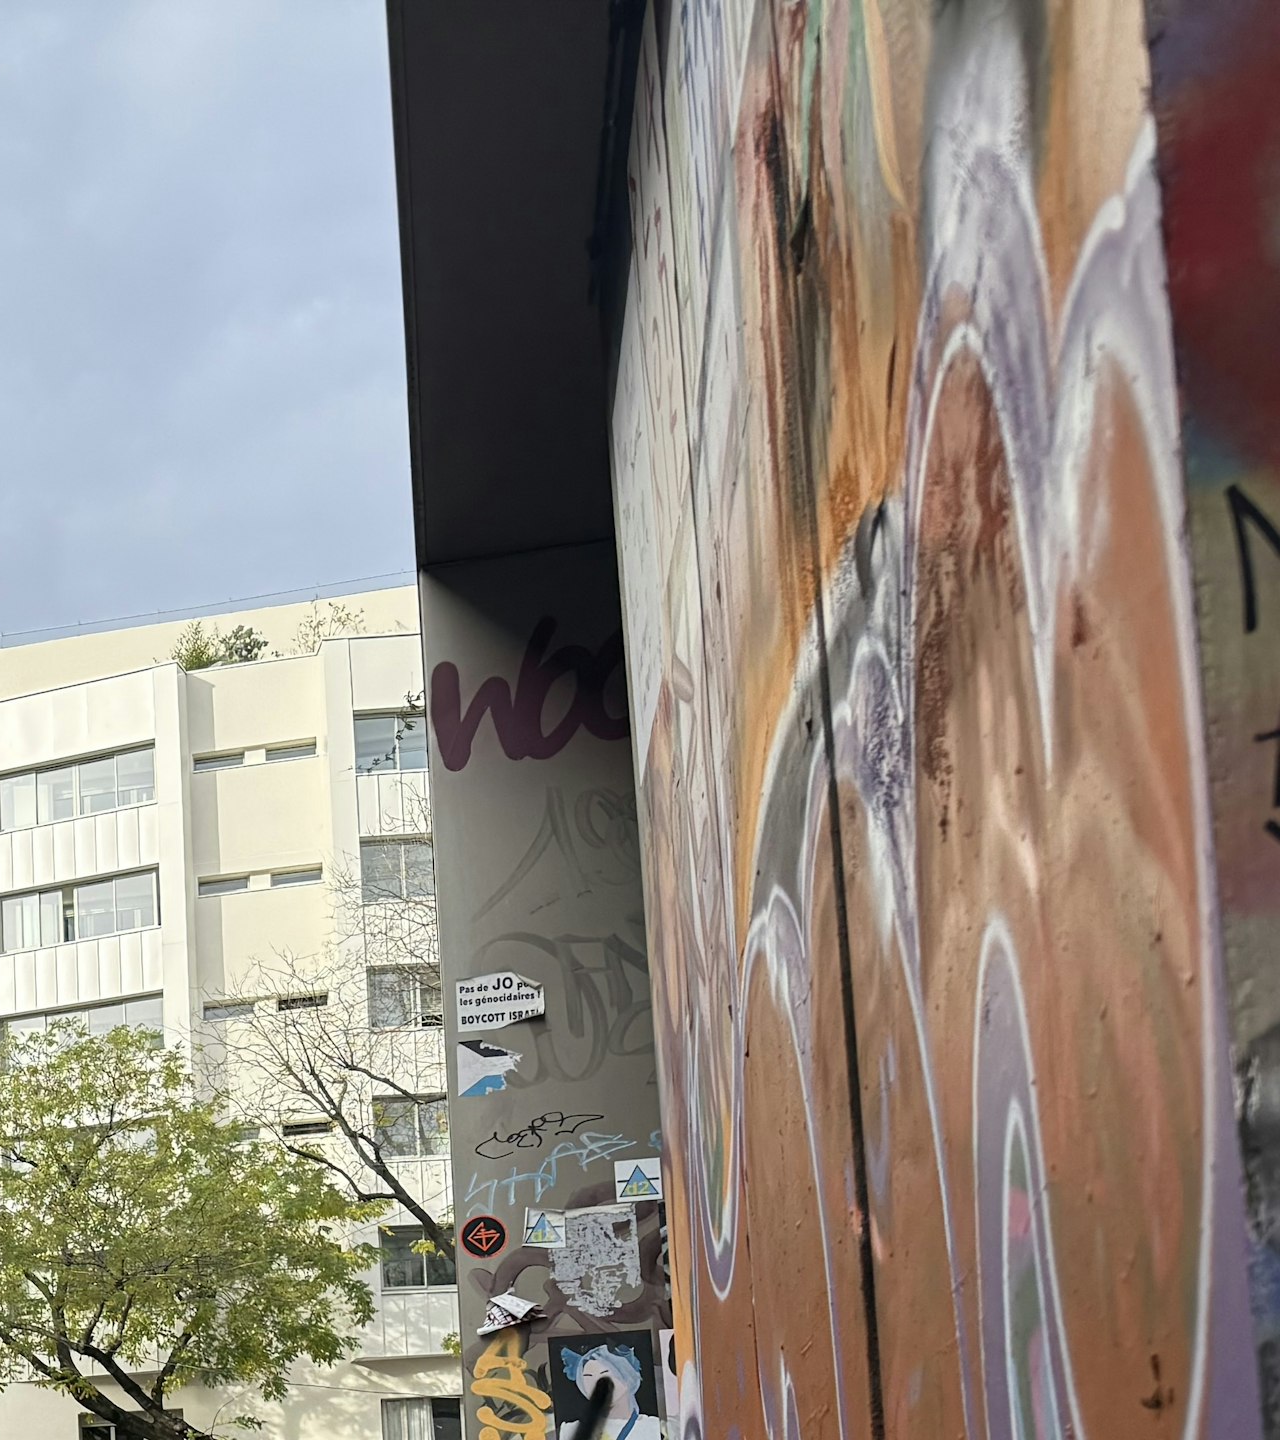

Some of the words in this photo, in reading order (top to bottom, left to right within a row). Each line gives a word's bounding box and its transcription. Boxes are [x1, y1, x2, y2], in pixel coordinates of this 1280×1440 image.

[459, 986, 475, 994] Pas
[477, 984, 489, 992] de
[492, 976, 513, 991] JO
[459, 998, 473, 1006] les
[475, 992, 535, 1007] génocidaires
[461, 1012, 506, 1025] BOYCOTT
